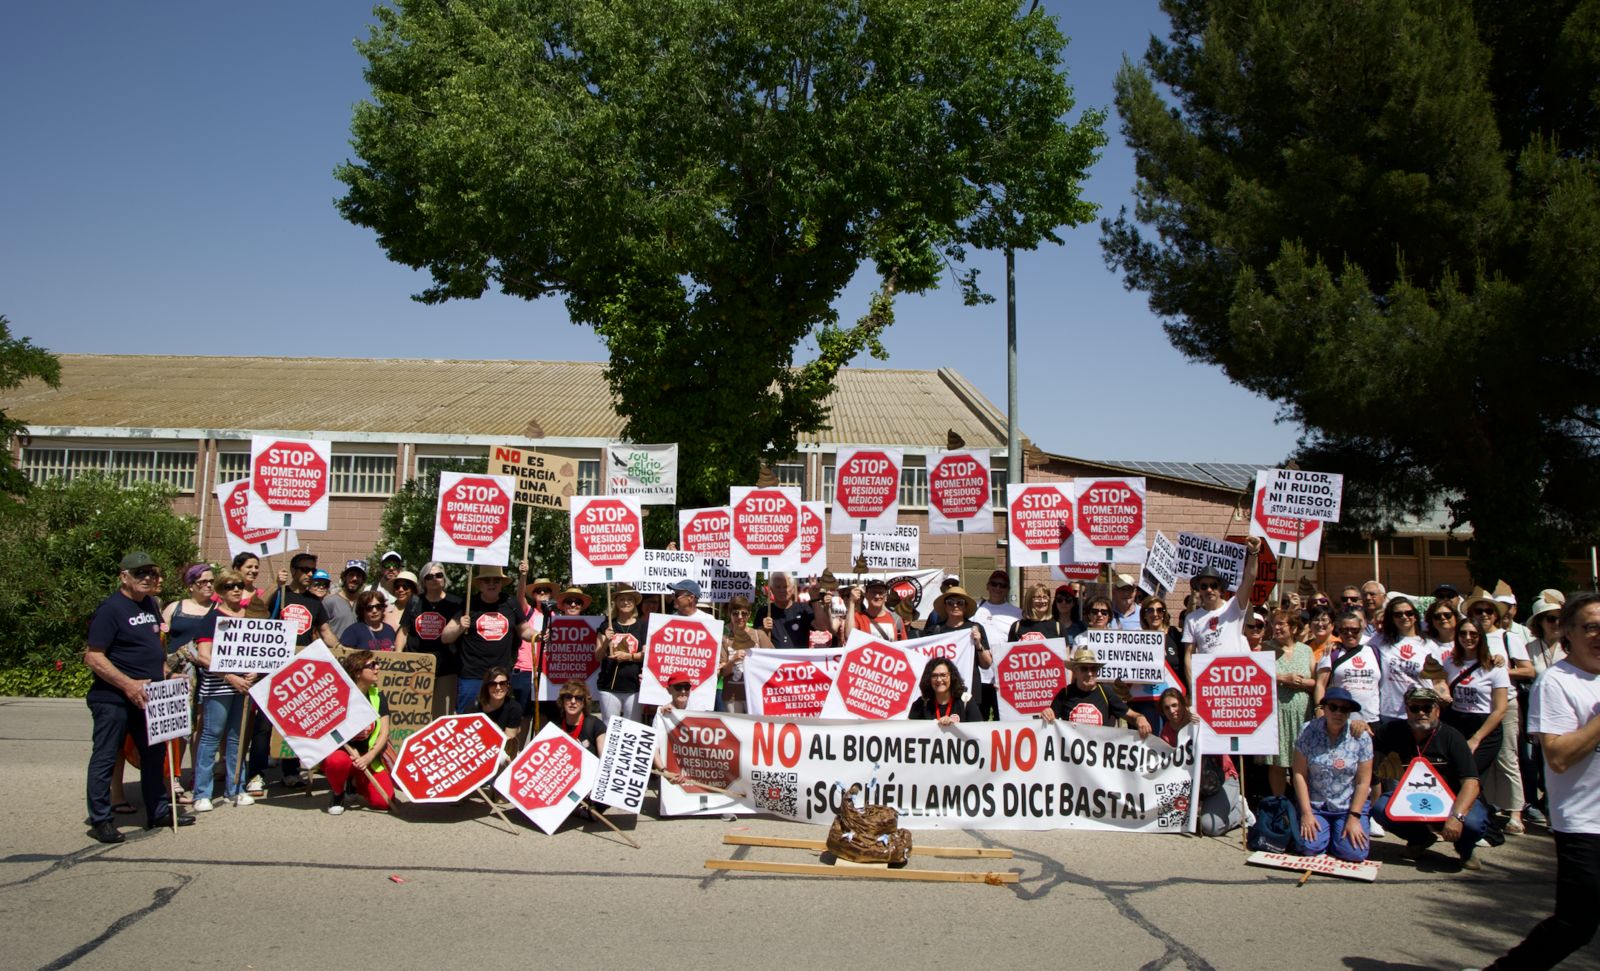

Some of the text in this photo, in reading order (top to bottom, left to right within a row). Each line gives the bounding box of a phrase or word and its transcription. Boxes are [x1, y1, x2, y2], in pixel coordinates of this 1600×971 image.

[269, 449, 314, 466] STOP
[496, 448, 544, 467] NO ES
[261, 466, 321, 479] BIOMETANO
[502, 464, 561, 482] ENERGÍA,
[850, 459, 888, 474] STOP
[940, 462, 976, 477] STOP
[272, 478, 317, 488] RESIDUOS
[612, 478, 627, 486] NO
[843, 476, 893, 485] BIOMETANO
[935, 477, 983, 488] BIOMETANO
[1278, 471, 1331, 483] NI OLOR,
[268, 487, 310, 498] MÉDICOS
[456, 485, 499, 501] STOP
[520, 480, 547, 492] UNA
[851, 487, 889, 495] RESIDUOS
[944, 488, 981, 496] RESIDUOS
[1274, 482, 1333, 497] NI RUIDO,
[848, 495, 883, 504] MÉDICOS
[943, 497, 976, 506] MÉDICOS
[1023, 494, 1061, 508] STOP
[1090, 489, 1130, 503] STOP
[1270, 493, 1336, 508] NI RIESGO:
[447, 502, 505, 514] BIOMETANO
[746, 498, 786, 512] STOP
[1083, 506, 1137, 515] BIOMETANO
[457, 514, 500, 524] RESIDUOS
[586, 507, 627, 522] STOP
[739, 514, 792, 524] BIOMETANO
[1017, 509, 1068, 519] BIOMETANO
[1306, 508, 1332, 518] PLANTAS!
[454, 522, 493, 533] MÉDICOS
[580, 524, 634, 534] BIOMETANO
[1091, 524, 1128, 533] MÉDICOS
[591, 535, 632, 543] RESIDUOS
[747, 534, 784, 542] MÉDICOS
[589, 543, 627, 553] MÉDICOS
[871, 542, 910, 551] ENVENENA
[1179, 535, 1244, 560] SOCUÉLLAMOS
[645, 552, 694, 562] ES PROGRESO
[891, 557, 916, 567] TIERRA
[1178, 548, 1238, 572] NO SE VENDE,
[649, 568, 687, 576] ENVENENA
[1174, 561, 1188, 574] ¡SE
[712, 581, 752, 590] RIESGO:
[228, 619, 242, 629] NI
[247, 621, 286, 632] OLOR,
[223, 632, 287, 646] NI RUIDO,
[551, 627, 590, 641] STOP
[664, 627, 707, 645] STOP
[1089, 633, 1163, 645] NO ES PROGRESO
[217, 646, 290, 658] NI RIESGO:
[655, 643, 712, 658] BIOMETANO
[1098, 650, 1154, 662] SI ENVENENA
[238, 659, 243, 668] A
[244, 659, 256, 669] LAS
[552, 654, 592, 662] RESIDUOS
[664, 656, 707, 668] RESIDUOS
[860, 648, 906, 676] STOP
[1009, 652, 1051, 669] STOP
[775, 665, 816, 682] STOP
[848, 663, 908, 693] BIOMETANO
[1004, 667, 1061, 682] BIOMETANO
[1131, 668, 1162, 680] TIERRA
[1210, 665, 1257, 683] STOP
[273, 663, 316, 701] STOP
[766, 682, 830, 696] BIOMETANO
[1015, 679, 1058, 690] RESIDUOS
[277, 672, 334, 718] BIOMETANO
[849, 685, 891, 709] MÉDICOS
[855, 679, 900, 701] RESIDUOS
[1014, 690, 1053, 700] MÉDICOS
[1202, 685, 1266, 696] BIOMETANO
[295, 685, 338, 720] RESIDUOS
[423, 695, 432, 709] Y
[771, 694, 816, 703] RESIDUOS
[1214, 698, 1262, 707] RESIDUOS
[148, 704, 156, 717] NO
[158, 702, 165, 716] SE
[299, 697, 340, 729] MÉDICOS
[1212, 706, 1256, 718] MÉDICOS
[160, 715, 188, 734] DEFIENDE!
[410, 719, 458, 757] STOP
[679, 726, 727, 746] STOP
[608, 733, 620, 755] QUIERE
[752, 721, 802, 768] NO
[809, 734, 836, 760] AL
[844, 735, 985, 769] BIOMETANO,
[990, 727, 1038, 772] NO
[1044, 736, 1054, 762] A
[1060, 737, 1097, 767] LOS
[422, 732, 481, 775] RESIDUOS
[426, 742, 486, 784] MEDICOS
[514, 742, 551, 783] STOP
[611, 732, 637, 794] NO PLANTAS
[624, 730, 656, 808] QUE MATAN
[426, 744, 500, 798] SOCUELLAMOS
[518, 744, 568, 796] BIOMETANO
[535, 753, 572, 793] RESIDUOS
[539, 764, 574, 801] MÉDICOS
[1003, 783, 1055, 818] DICE
[1060, 783, 1146, 820] BASTA!
